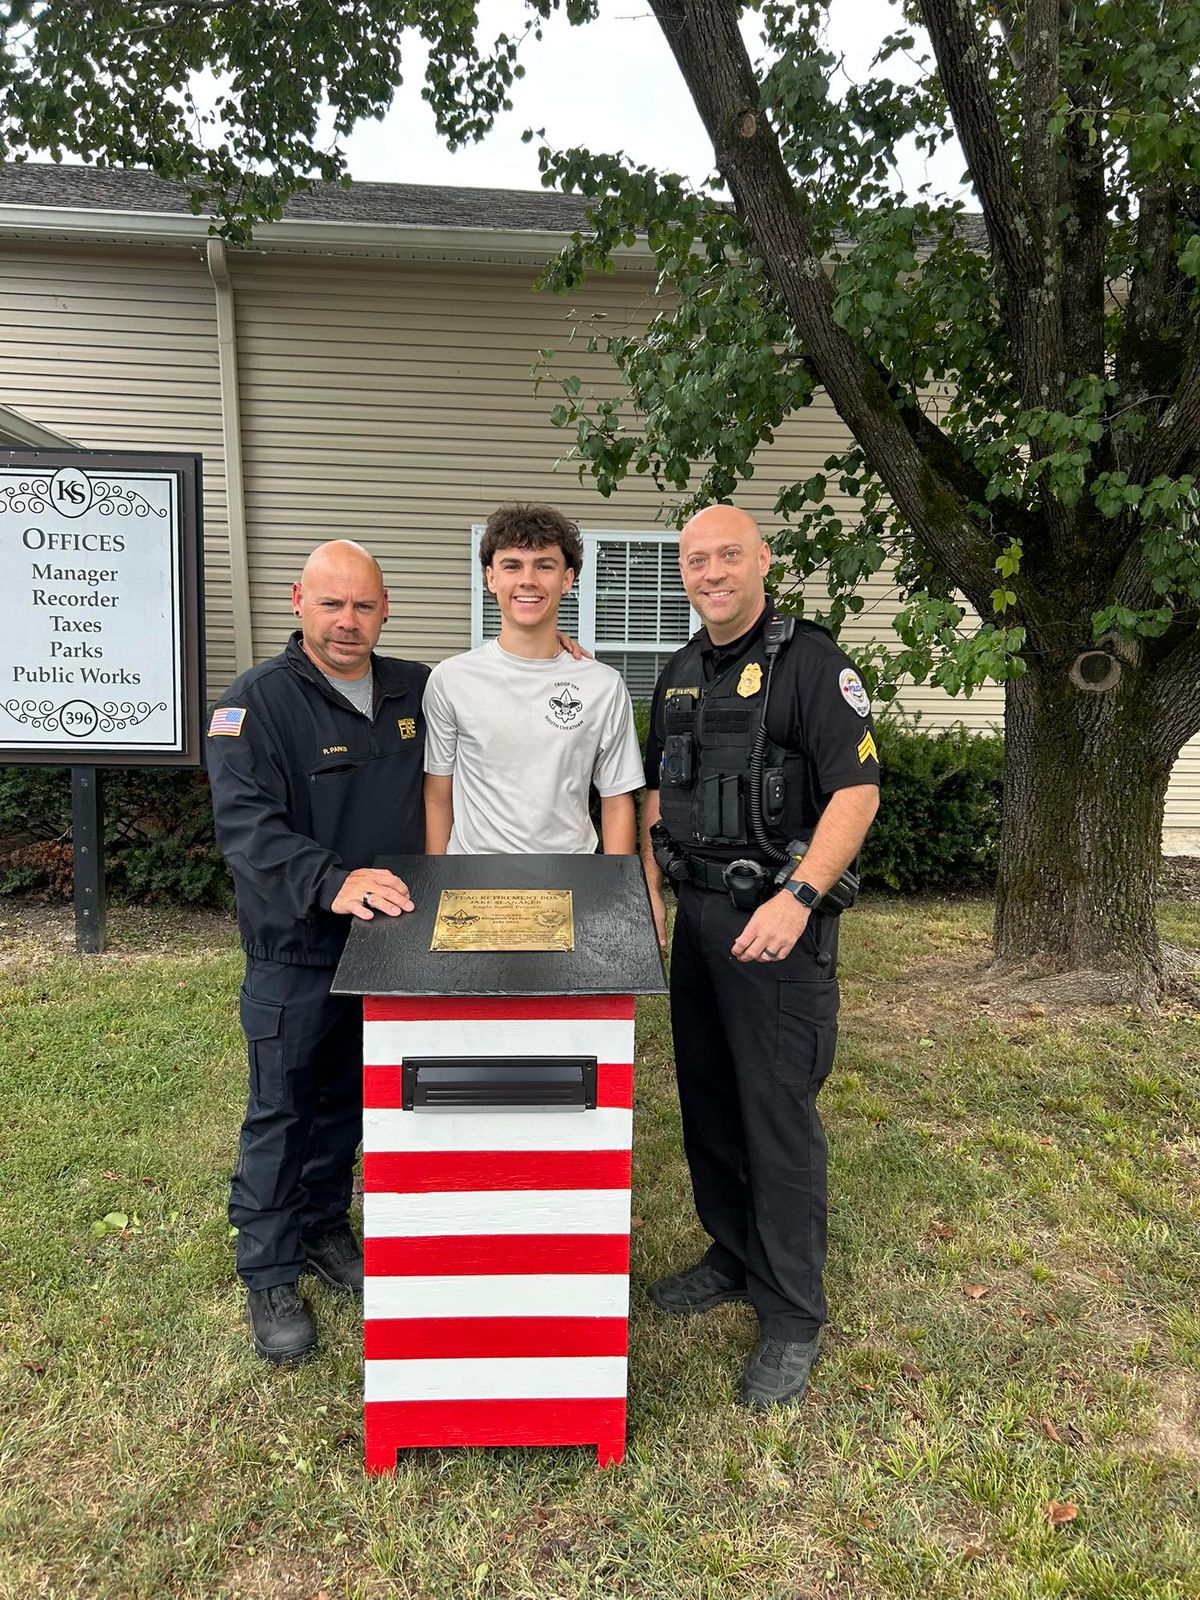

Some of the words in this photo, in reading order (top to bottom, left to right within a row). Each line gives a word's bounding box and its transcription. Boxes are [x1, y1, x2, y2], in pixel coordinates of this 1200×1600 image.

[56, 480, 86, 504] KS
[22, 528, 126, 552] OFFICES
[32, 563, 119, 586] Manager
[32, 589, 120, 608] Recorder
[49, 615, 103, 633] Taxes
[50, 641, 104, 659] Parks
[13, 666, 75, 683] Public
[80, 667, 142, 685] Works
[65, 711, 93, 725] 396
[545, 715, 559, 728] SOUTH
